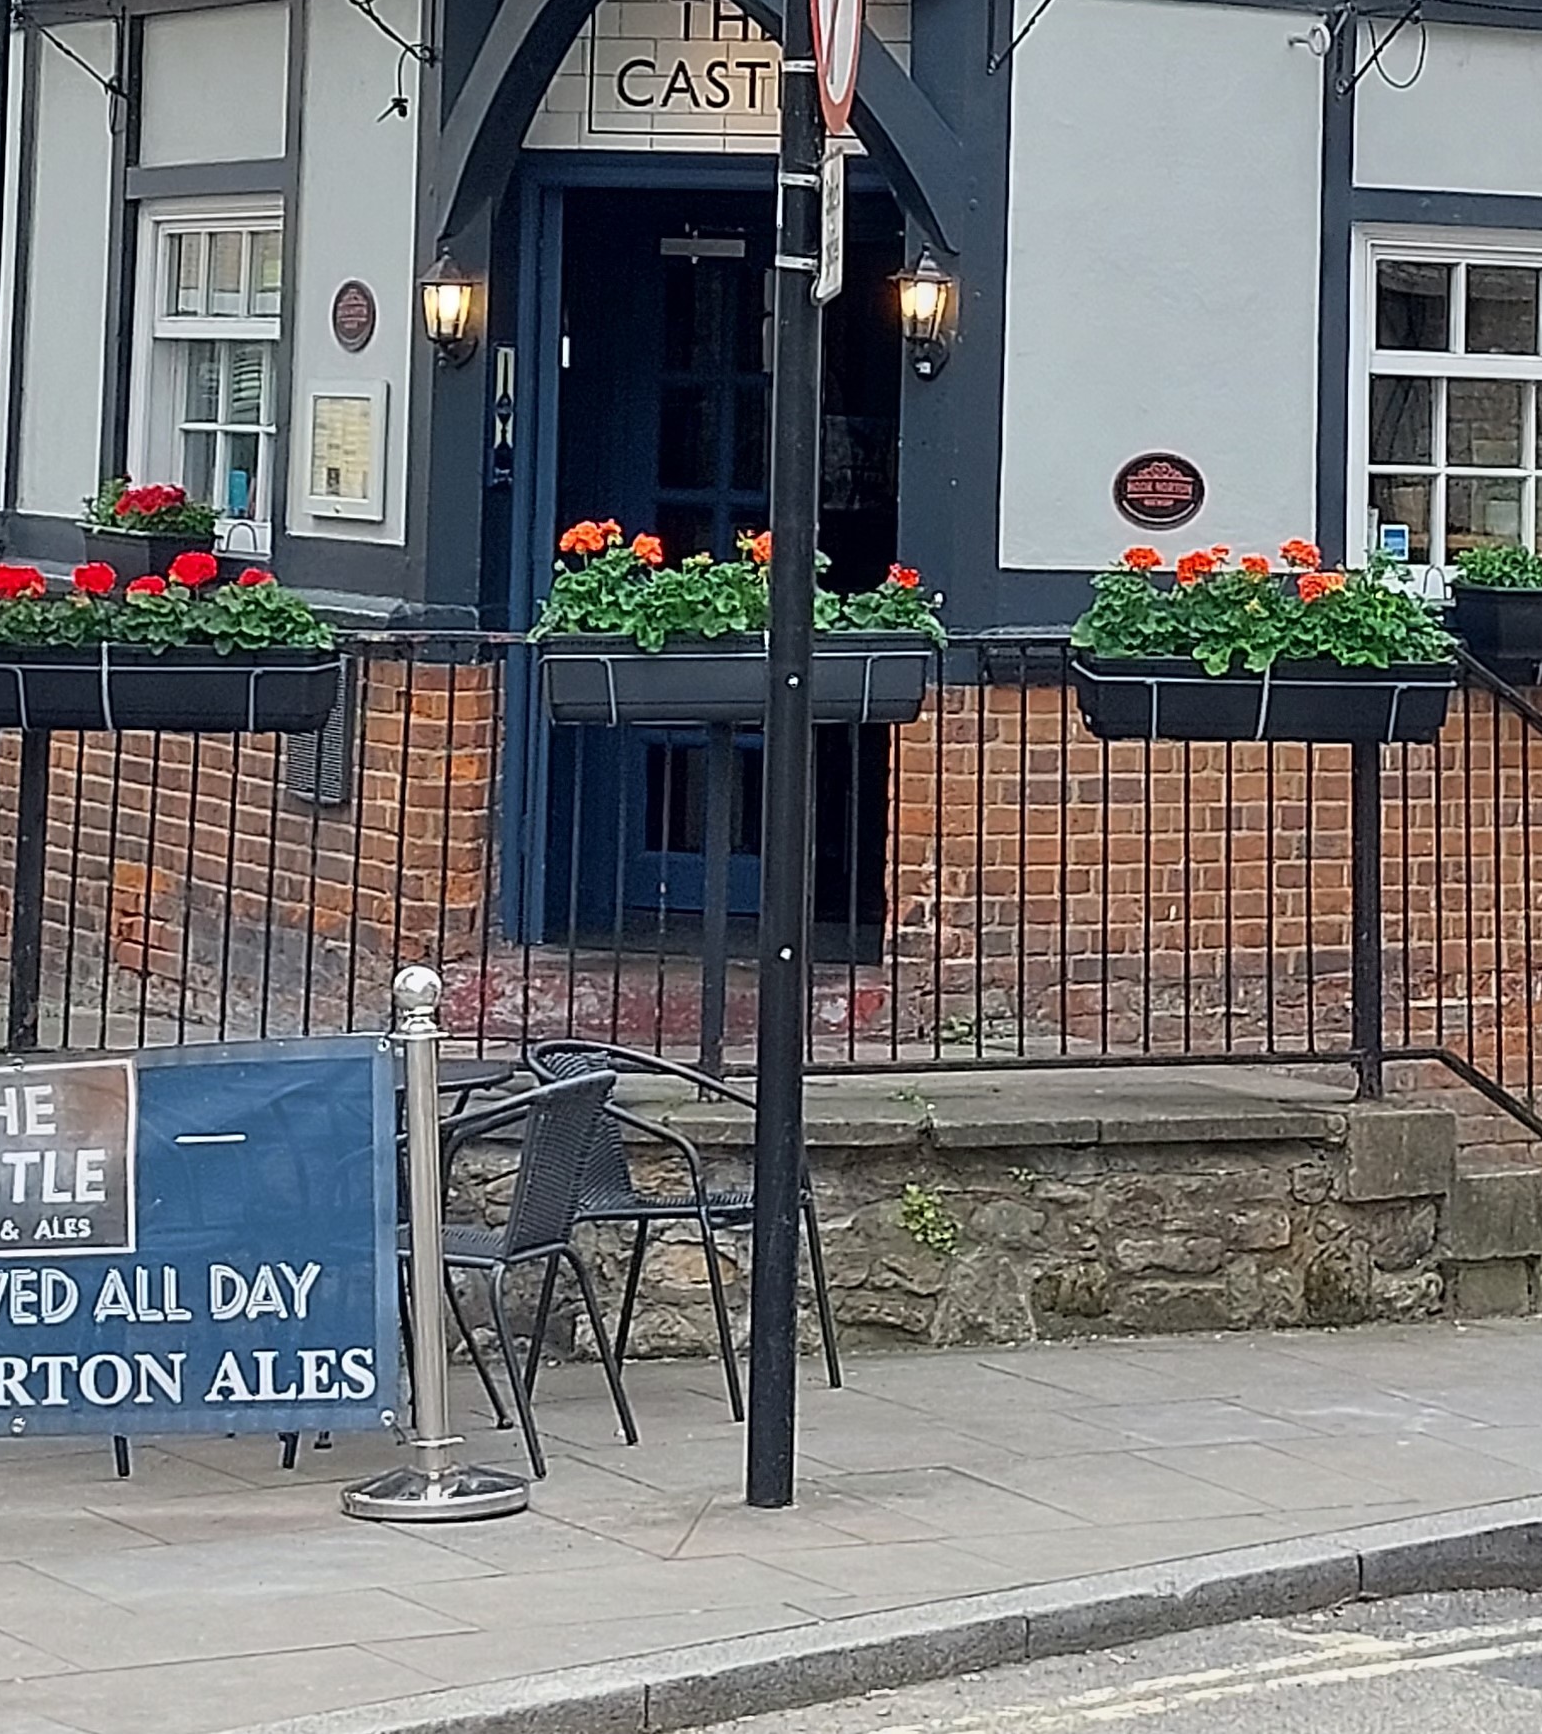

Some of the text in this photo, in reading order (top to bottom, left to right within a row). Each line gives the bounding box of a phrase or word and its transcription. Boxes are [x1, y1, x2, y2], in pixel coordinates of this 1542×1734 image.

[616, 59, 782, 109] CAST
[0, 1219, 20, 1242] &
[34, 1216, 93, 1242] ALES
[94, 1267, 194, 1323] ALL
[209, 1260, 322, 1322] DAY
[204, 1346, 378, 1403] ALES
